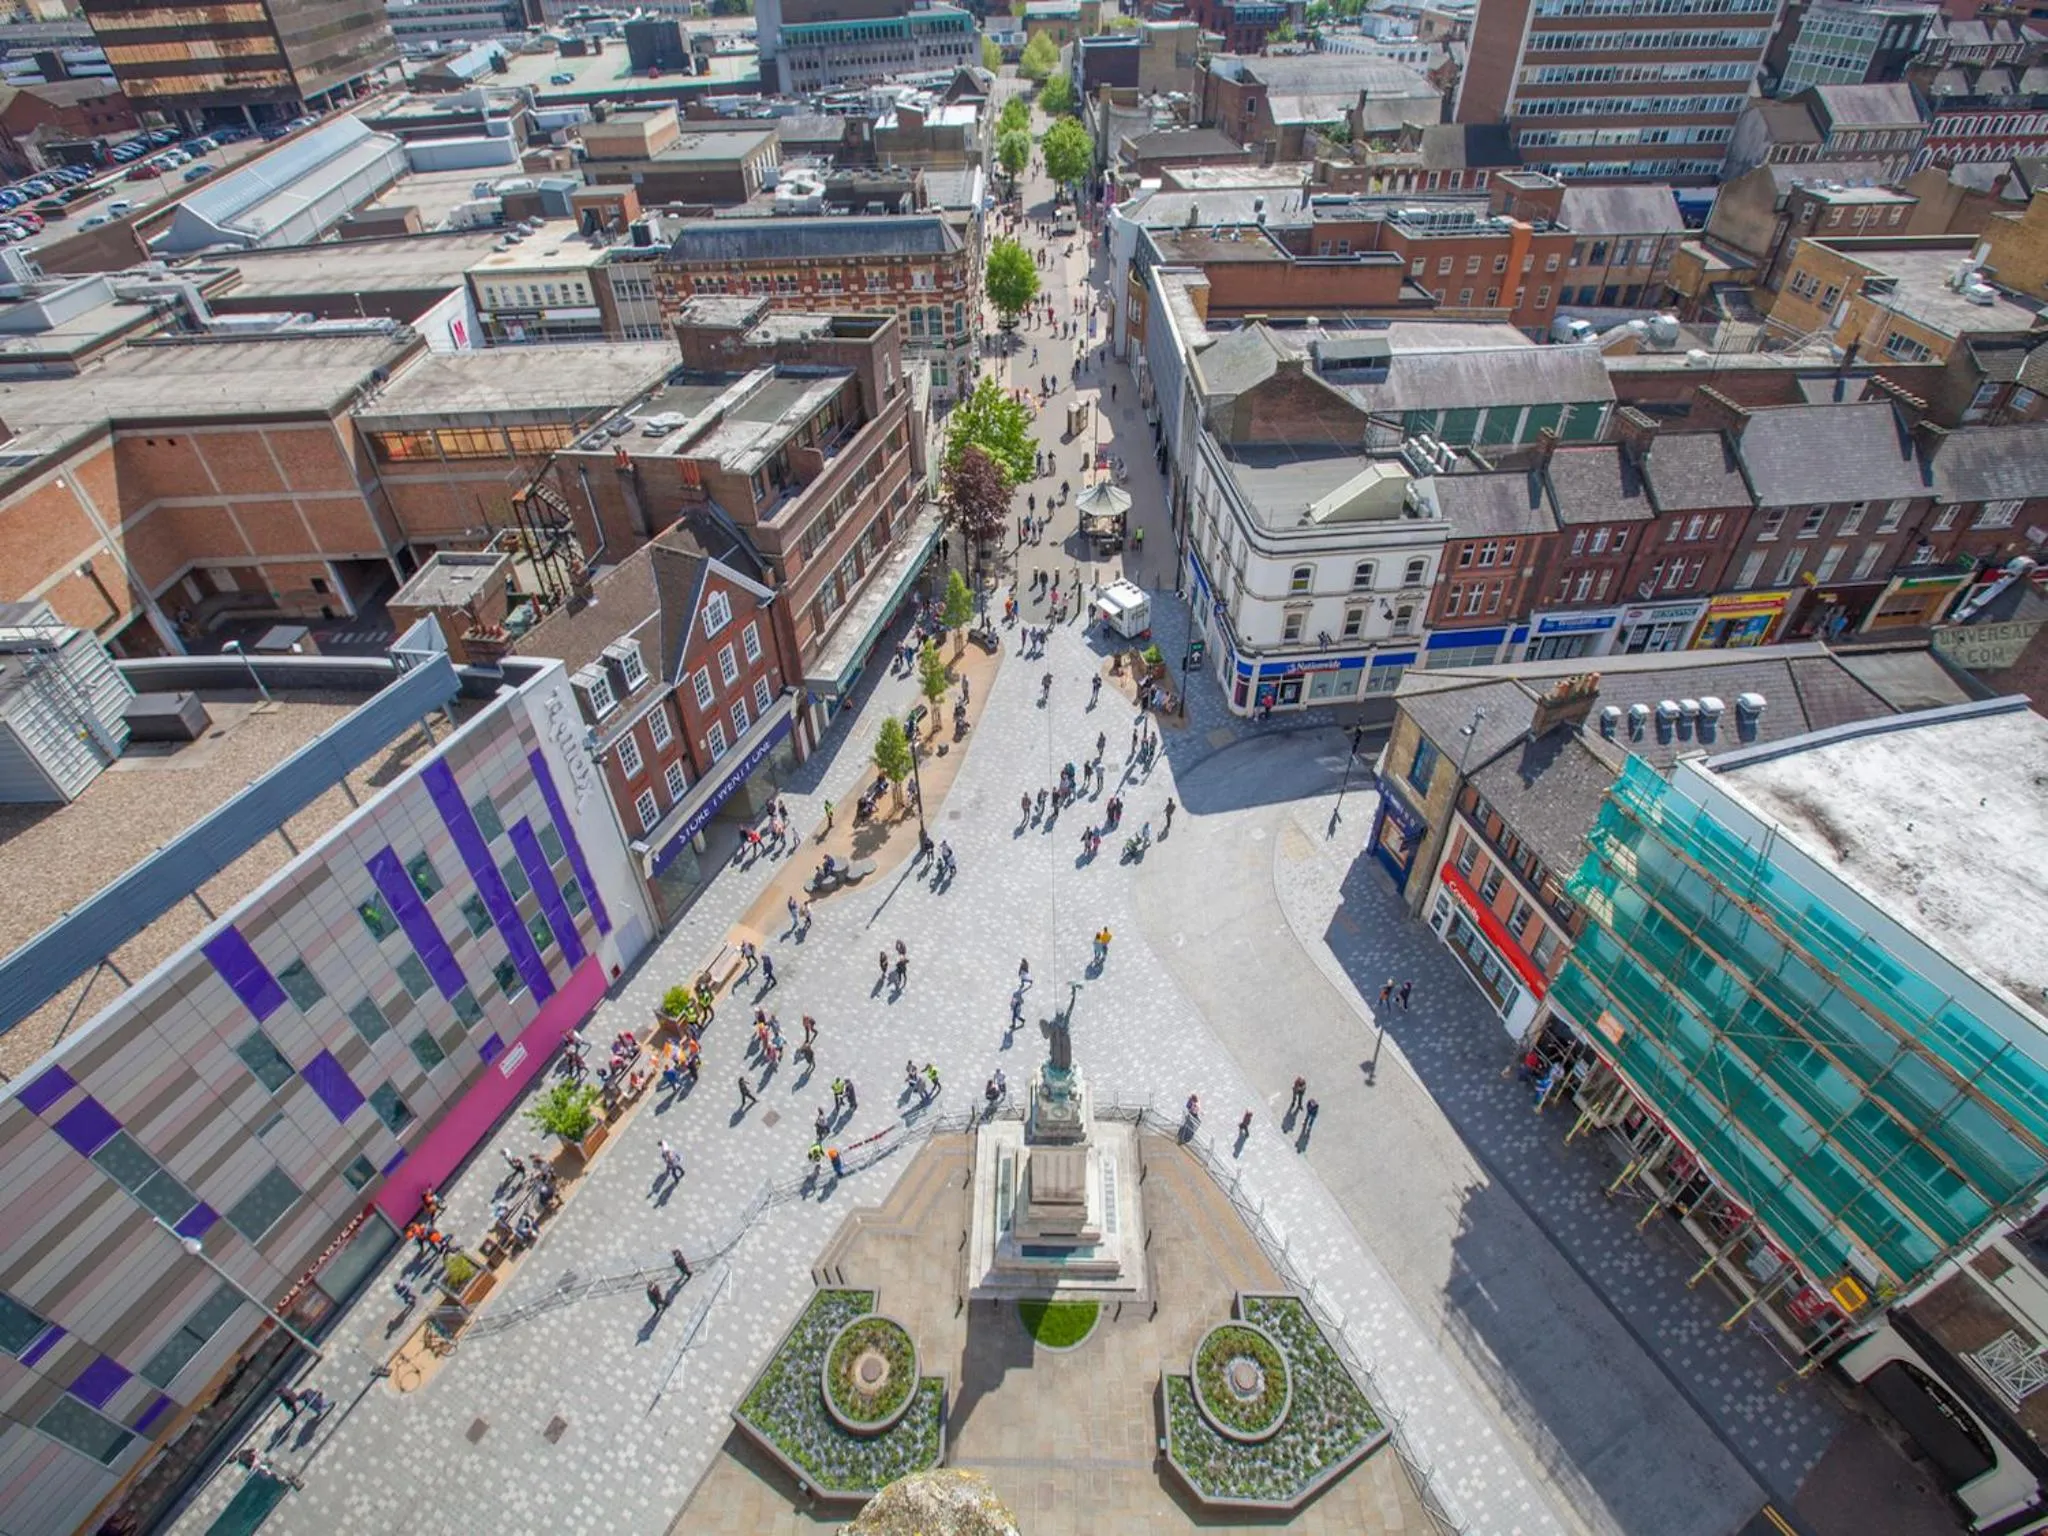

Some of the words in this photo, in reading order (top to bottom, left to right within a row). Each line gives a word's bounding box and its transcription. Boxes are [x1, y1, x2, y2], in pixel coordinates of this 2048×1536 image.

[1297, 659, 1341, 670] Nationwide
[712, 761, 751, 808] TWENTY
[751, 740, 772, 763] ONE
[273, 1278, 305, 1314] TOBY
[308, 1211, 363, 1274] CARVERY
